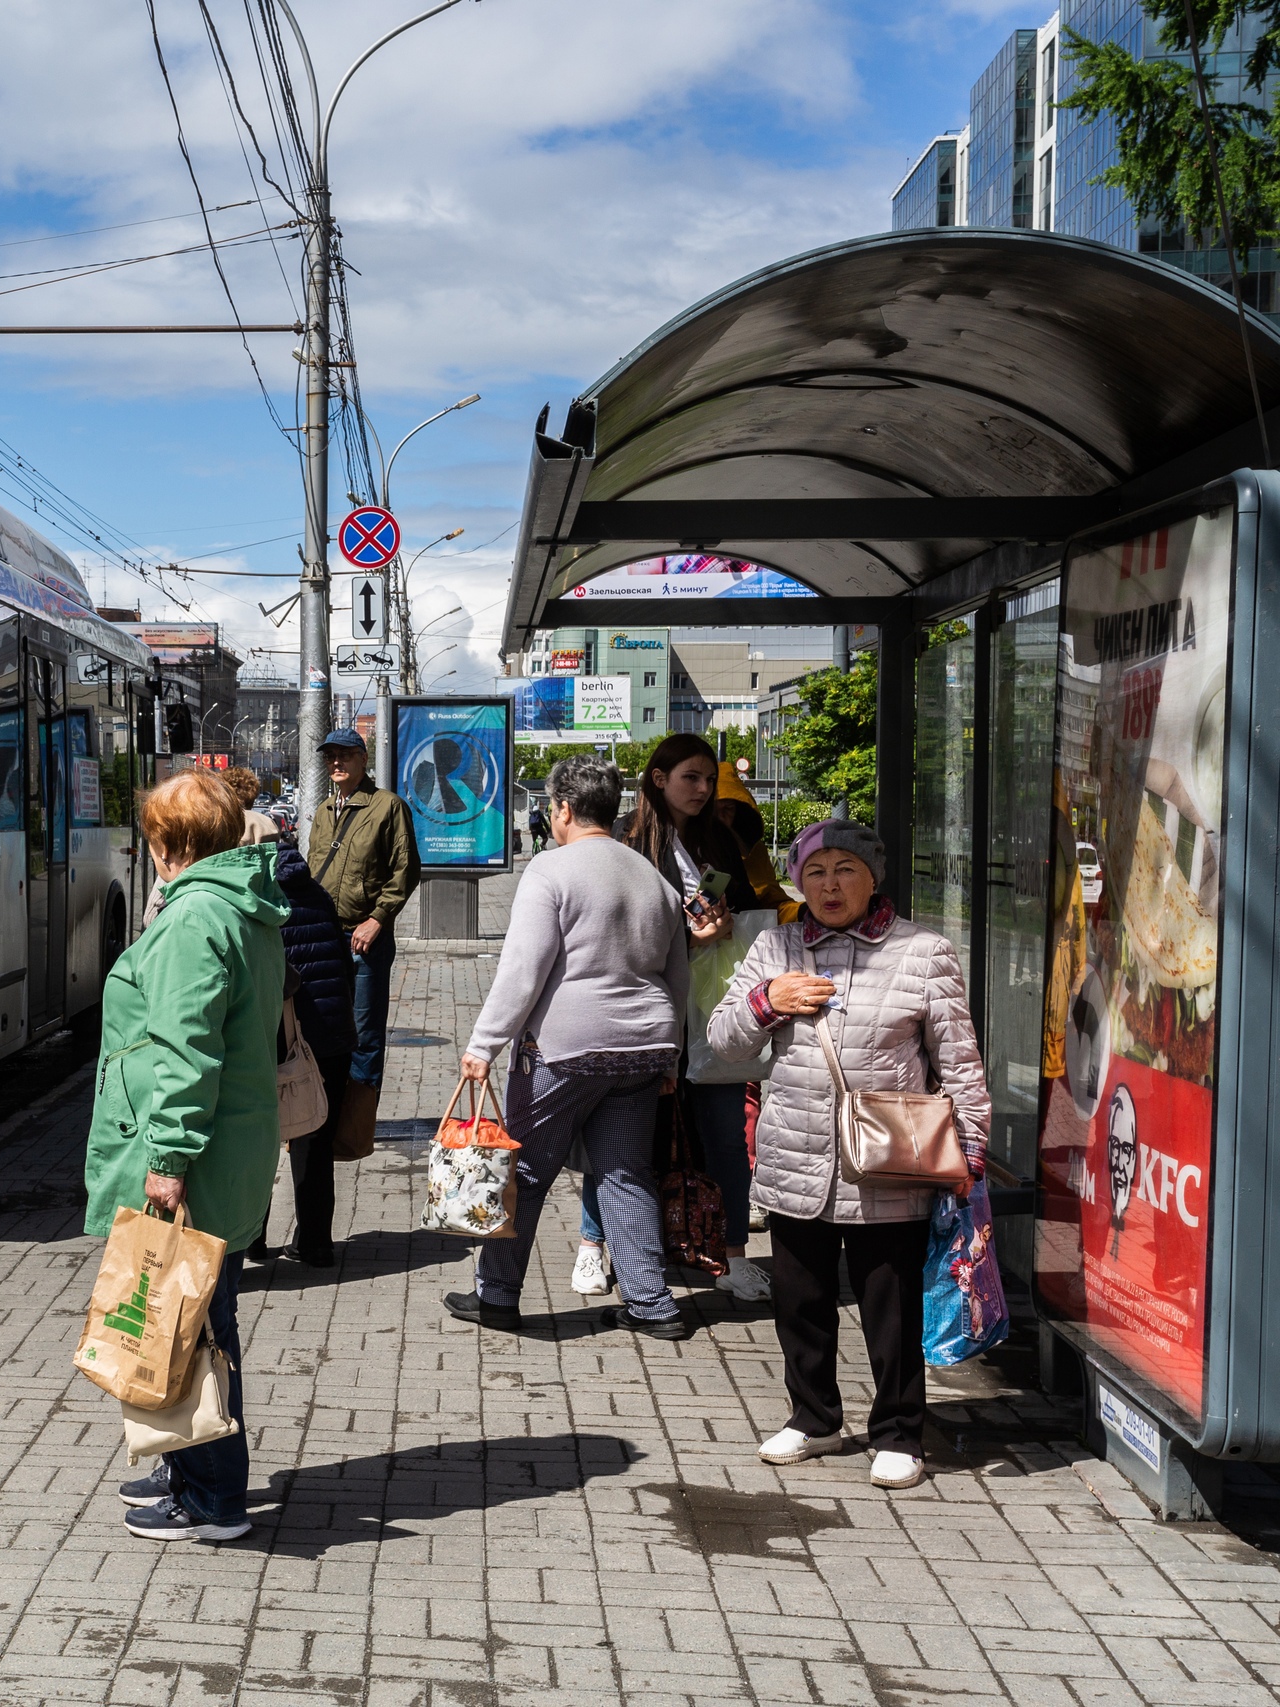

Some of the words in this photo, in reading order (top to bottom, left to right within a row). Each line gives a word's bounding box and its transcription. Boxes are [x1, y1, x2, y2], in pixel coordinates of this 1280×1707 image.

[588, 587, 652, 596] Заельцовская
[680, 586, 708, 594] минут
[1094, 608, 1144, 663] ЧИКЕН
[1145, 597, 1196, 657] ПИТА
[581, 681, 614, 691] berlin
[581, 705, 607, 721] 7,2
[1136, 1142, 1202, 1228] KFC
[145, 1248, 156, 1259] ТВОЙ
[143, 1256, 163, 1269] ПЕРВЫЙ
[121, 1343, 139, 1356] ПЛАНЕТЕ
